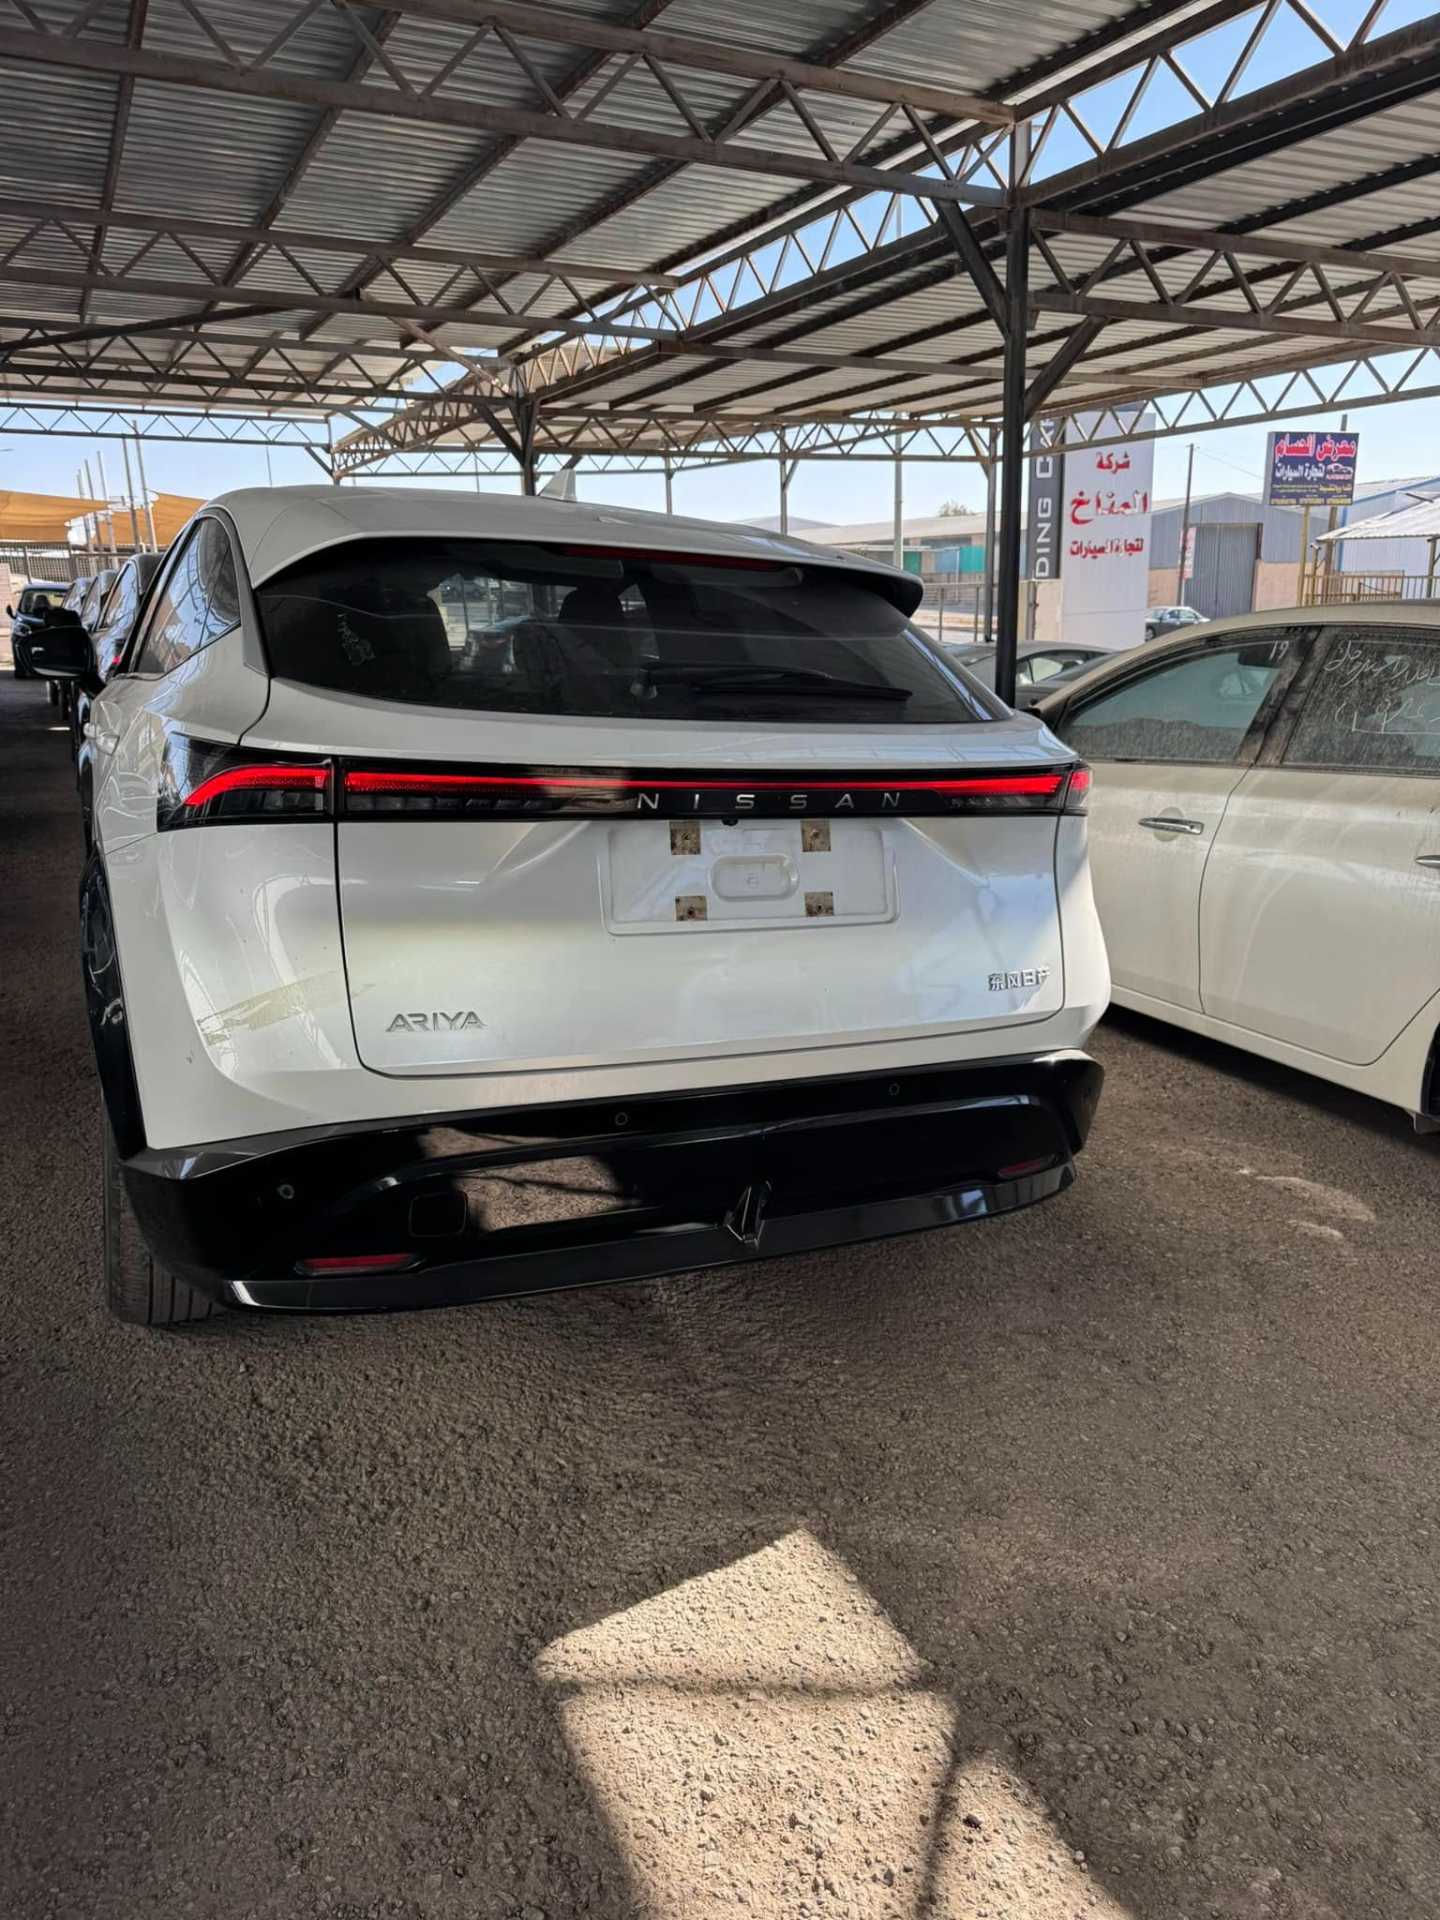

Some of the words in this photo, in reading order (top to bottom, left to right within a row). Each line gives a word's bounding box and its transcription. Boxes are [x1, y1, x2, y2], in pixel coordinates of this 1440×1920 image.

[1316, 434, 1356, 462] معرض
[1096, 450, 1131, 474] شركة
[1275, 462, 1304, 481] السيارات
[637, 793, 900, 810] NISSAN
[988, 965, 1051, 992] 东风日产
[385, 1010, 488, 1032] ARIYA
